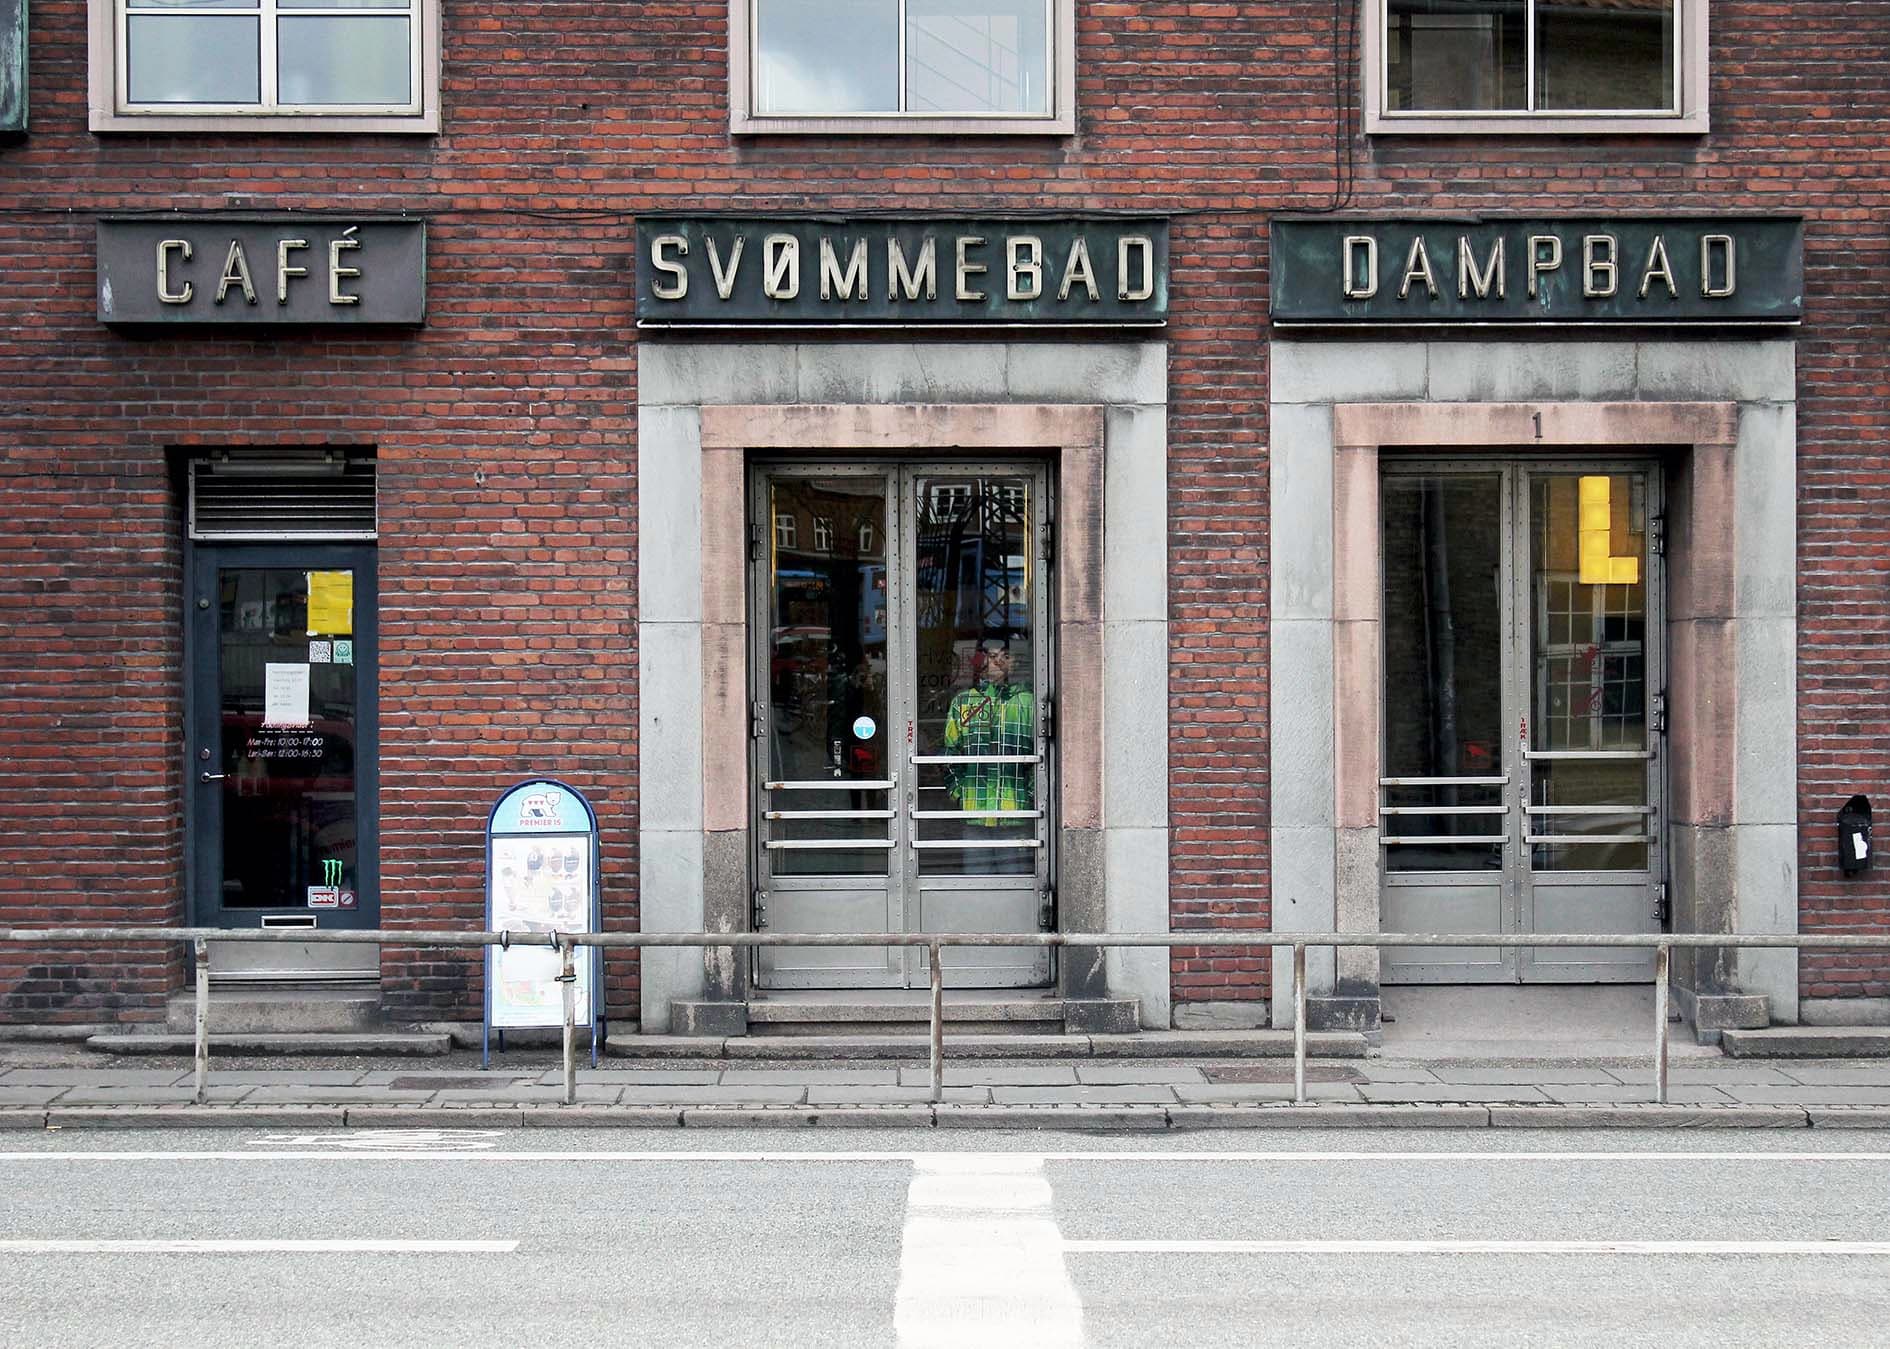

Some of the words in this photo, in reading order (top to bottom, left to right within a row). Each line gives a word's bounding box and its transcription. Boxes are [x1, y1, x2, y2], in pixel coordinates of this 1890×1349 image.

[156, 226, 361, 305] CAFÉ
[650, 233, 1154, 301] SVØMMEBAD
[1342, 234, 1737, 300] DAMPBAD
[1532, 411, 1543, 438] 1
